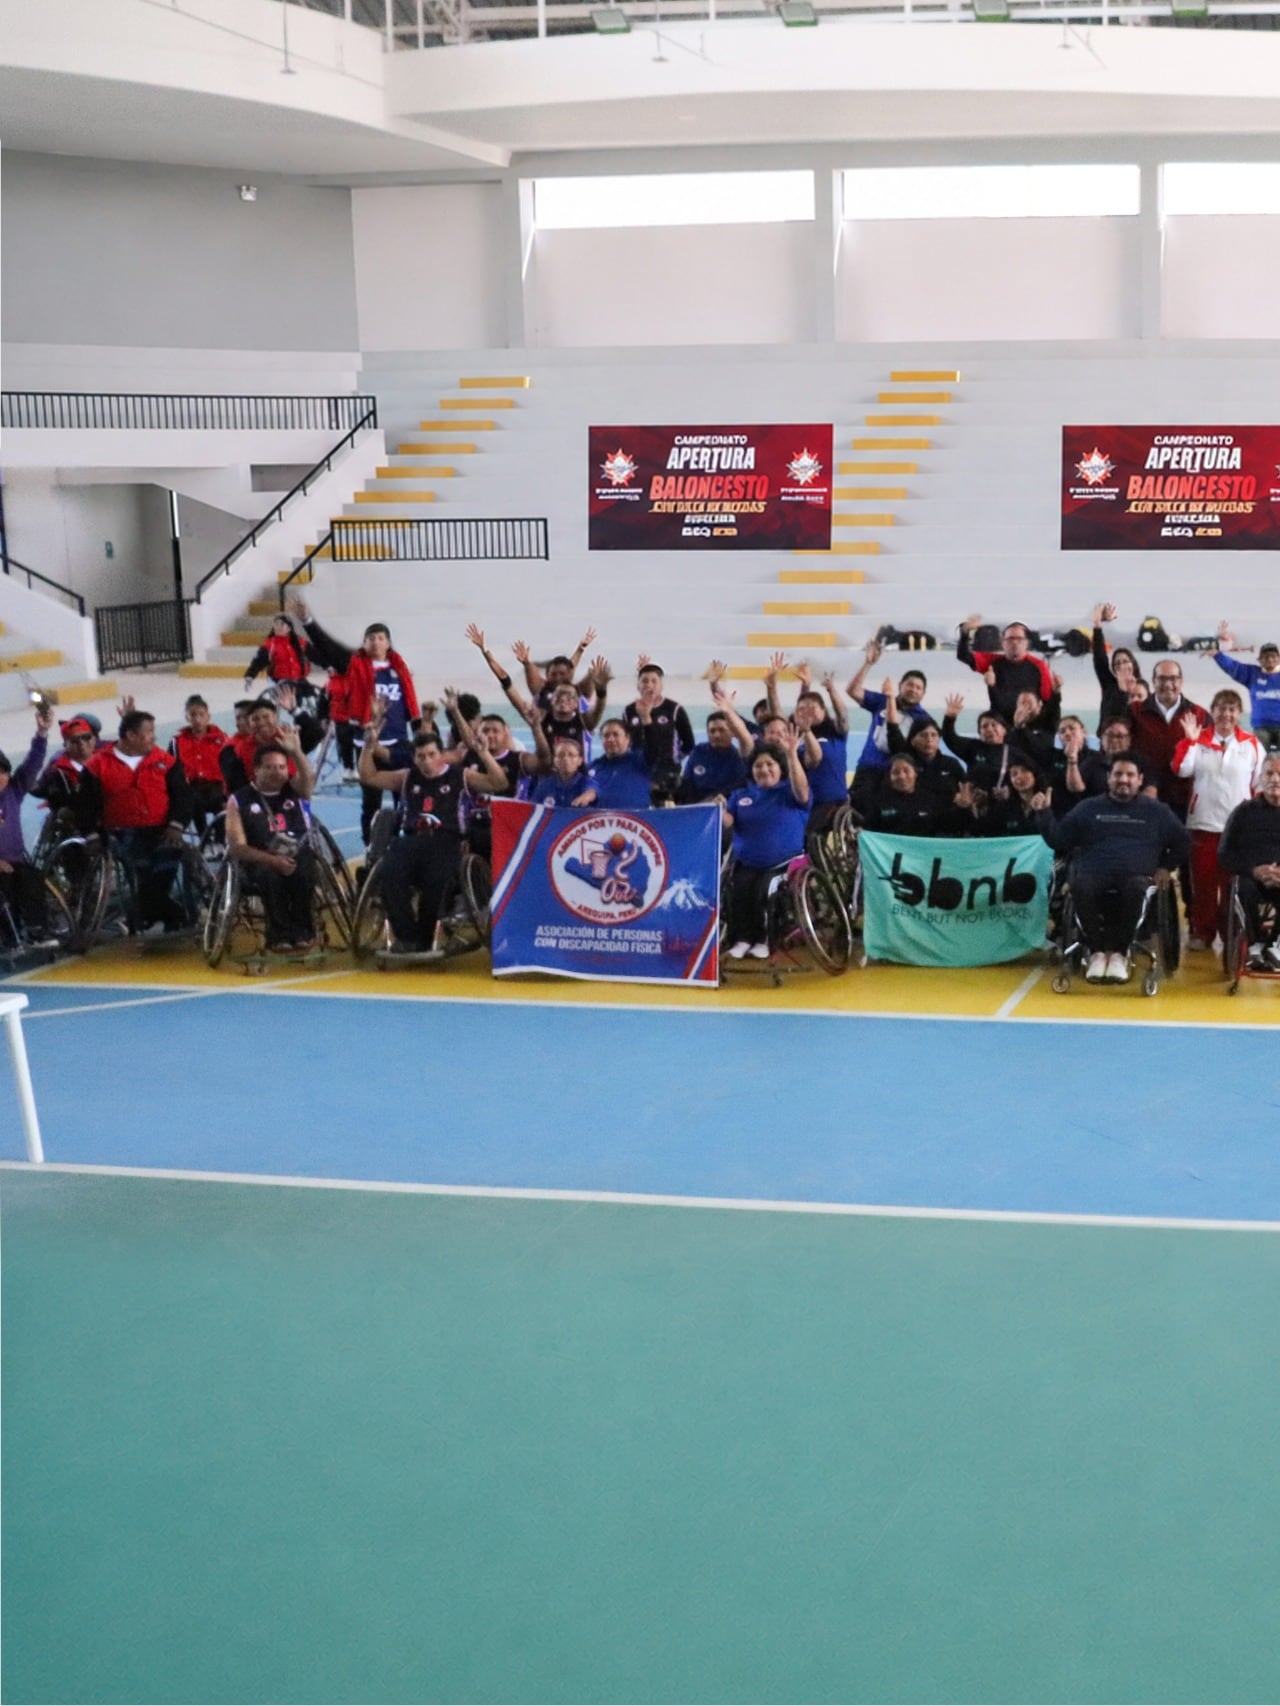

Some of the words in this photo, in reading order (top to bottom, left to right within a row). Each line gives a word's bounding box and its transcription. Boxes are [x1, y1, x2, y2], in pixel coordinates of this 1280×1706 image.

[674, 435, 747, 445] CAMPEONATO
[1154, 435, 1233, 445] CAMPEONATO
[666, 447, 755, 472] APERTURA
[1144, 447, 1241, 473] APERTURA
[649, 475, 769, 500] BALONCESTO
[1126, 475, 1256, 500] BALONCESTO
[588, 820, 606, 831] POR
[878, 853, 1037, 910] bbnb
[927, 912, 950, 924] BUT
[956, 911, 984, 924] NOT
[536, 925, 595, 939] ASOCIACIÓN
[597, 928, 610, 939] DE
[612, 929, 663, 941] PERSONAS
[534, 938, 557, 948] CON
[558, 939, 629, 952] DISCAPACIDAD
